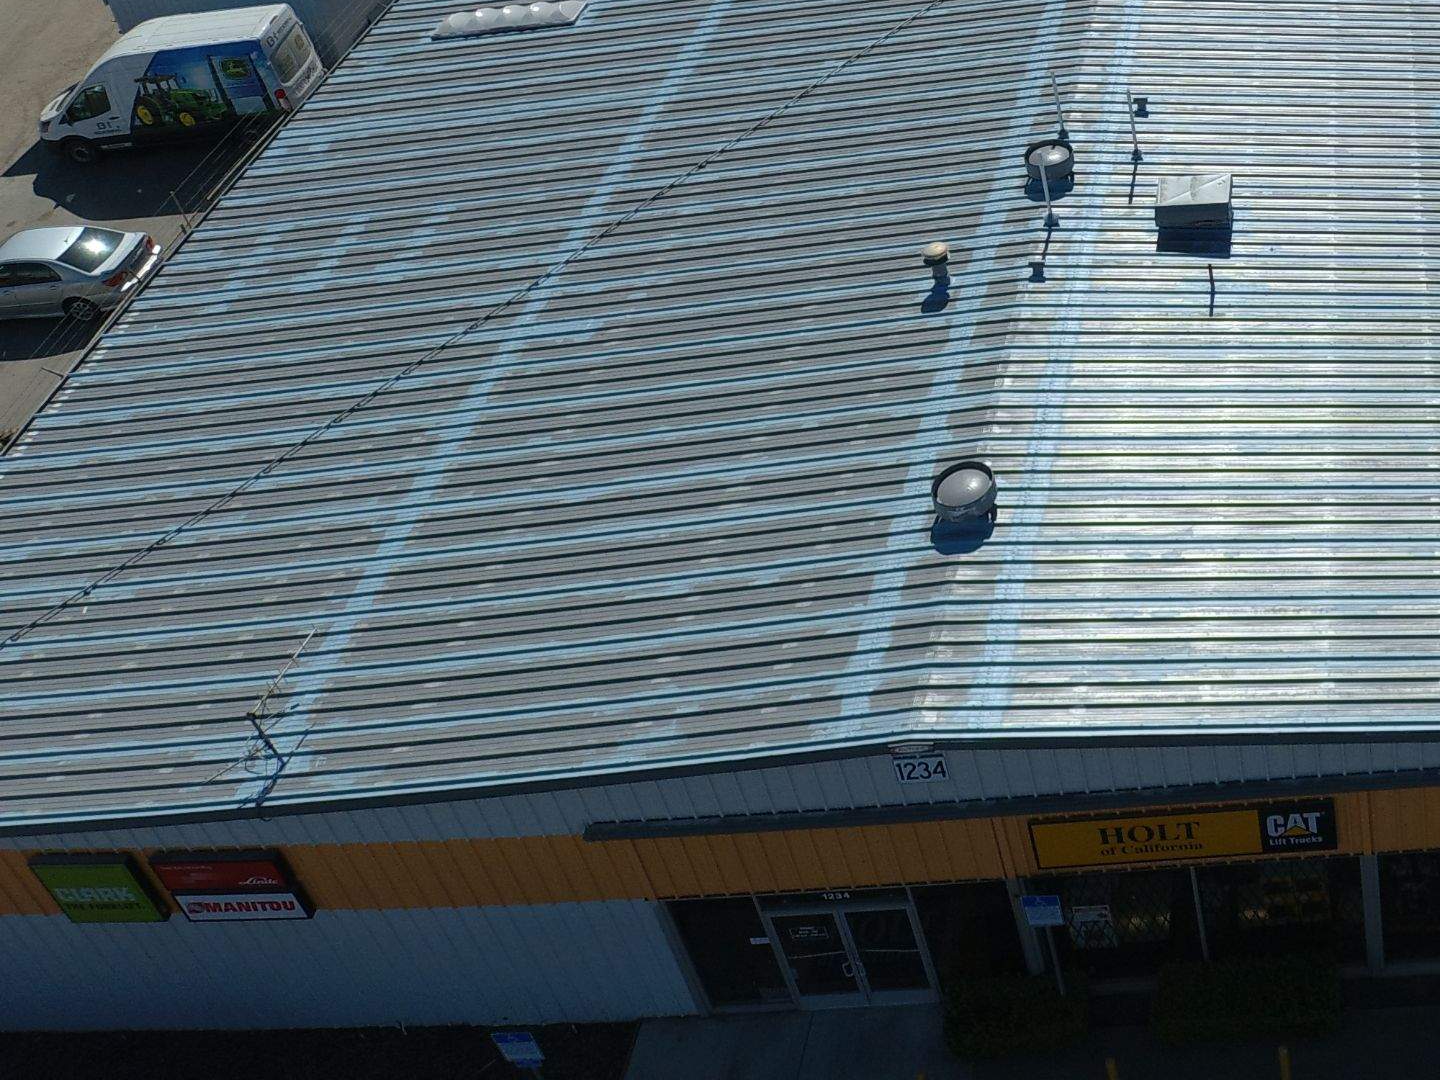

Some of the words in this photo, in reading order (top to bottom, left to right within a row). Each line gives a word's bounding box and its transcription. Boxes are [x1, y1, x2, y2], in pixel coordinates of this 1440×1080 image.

[895, 760, 946, 781] 1234
[1097, 821, 1201, 846] HOLT
[1266, 811, 1321, 837] CAT
[1269, 835, 1287, 847] Lift
[1289, 834, 1323, 845] Trucks
[204, 901, 296, 913] MANITOU
